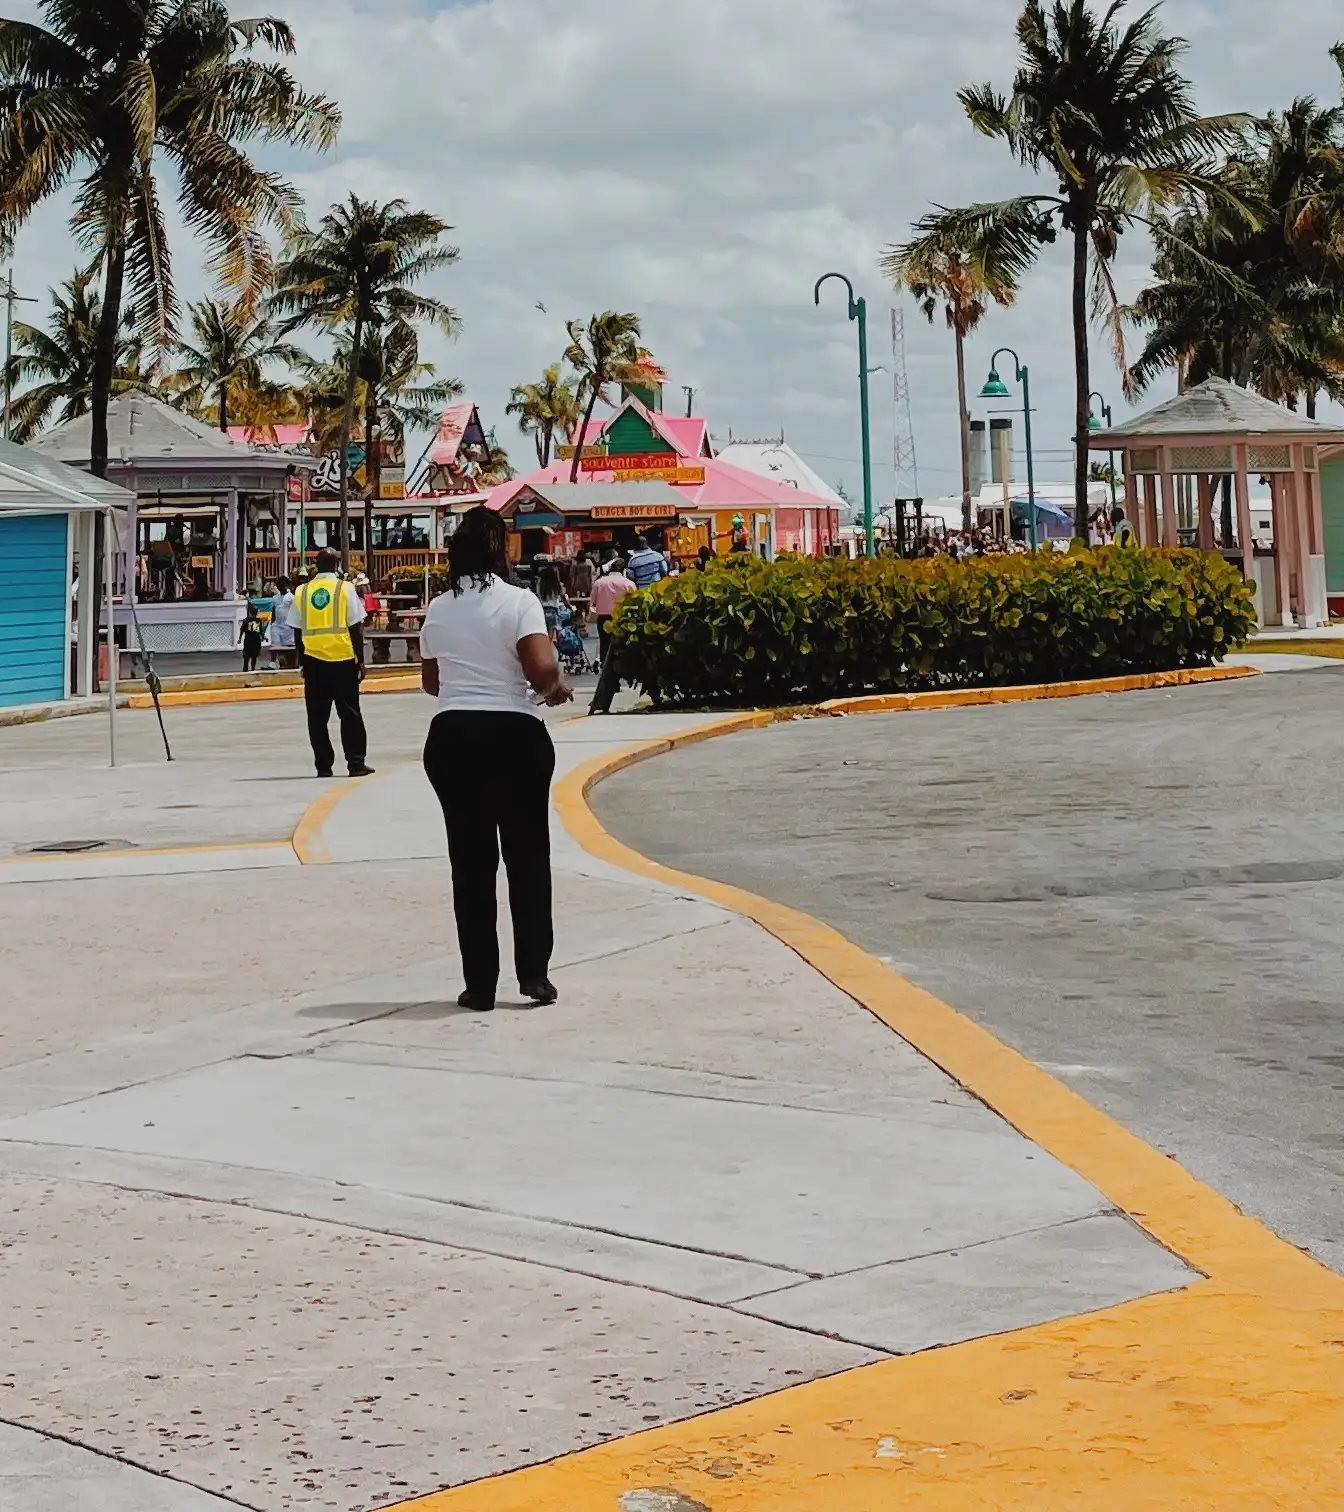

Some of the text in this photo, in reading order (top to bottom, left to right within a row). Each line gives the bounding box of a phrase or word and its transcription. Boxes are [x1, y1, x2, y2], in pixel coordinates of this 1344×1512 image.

[583, 454, 676, 470] souvenir store
[595, 506, 626, 517] BURGER
[629, 506, 646, 516] BOY
[654, 505, 672, 515] GIRL
